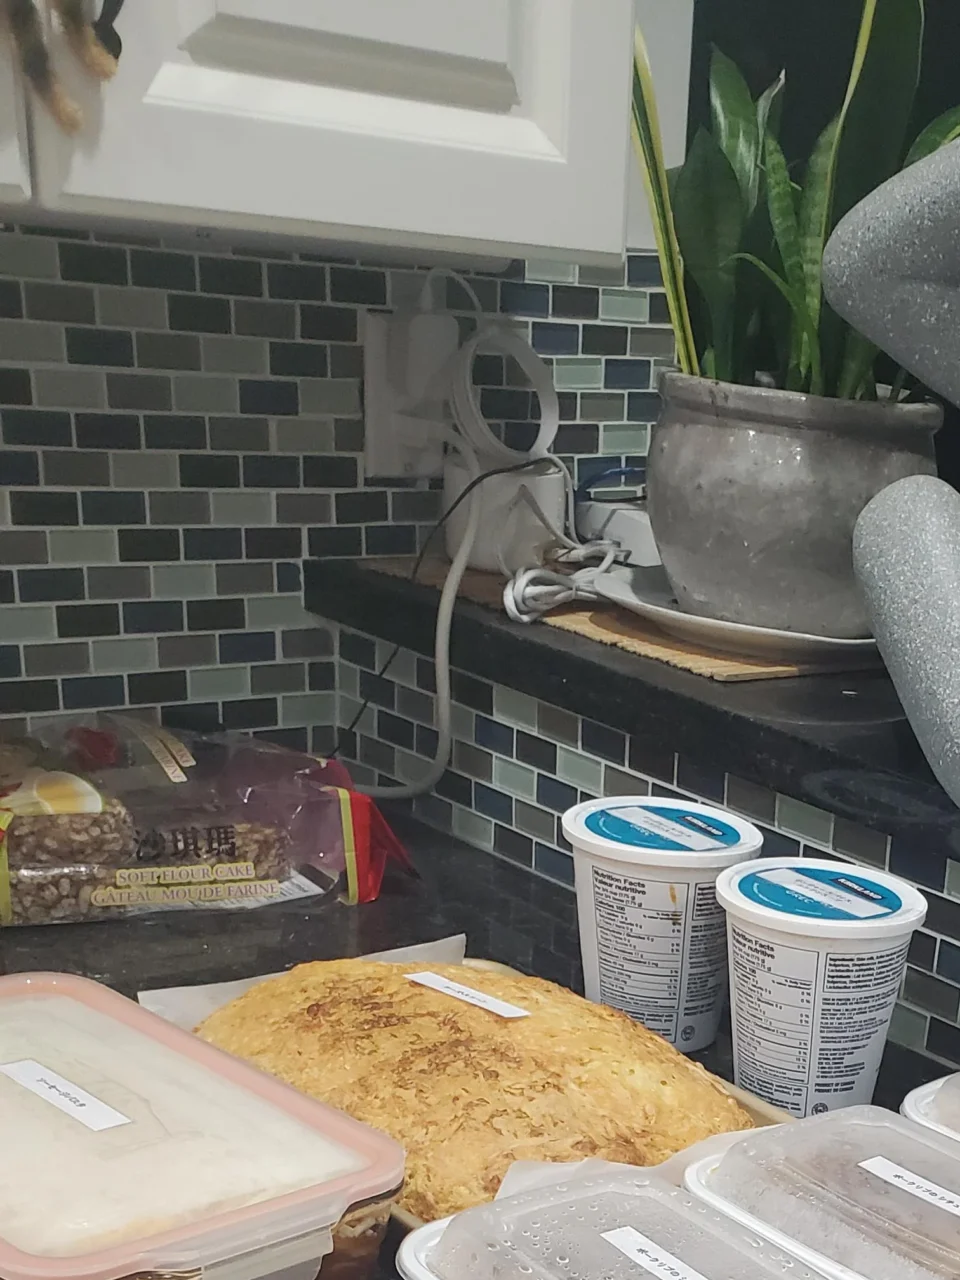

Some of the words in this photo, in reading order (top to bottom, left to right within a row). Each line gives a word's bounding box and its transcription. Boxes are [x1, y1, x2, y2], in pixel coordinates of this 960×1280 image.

[119, 870, 159, 884] SOFT
[162, 867, 212, 882] FLOUR
[215, 864, 254, 878] CAKE
[202, 886, 222, 899] DE
[227, 882, 278, 897] FARINE
